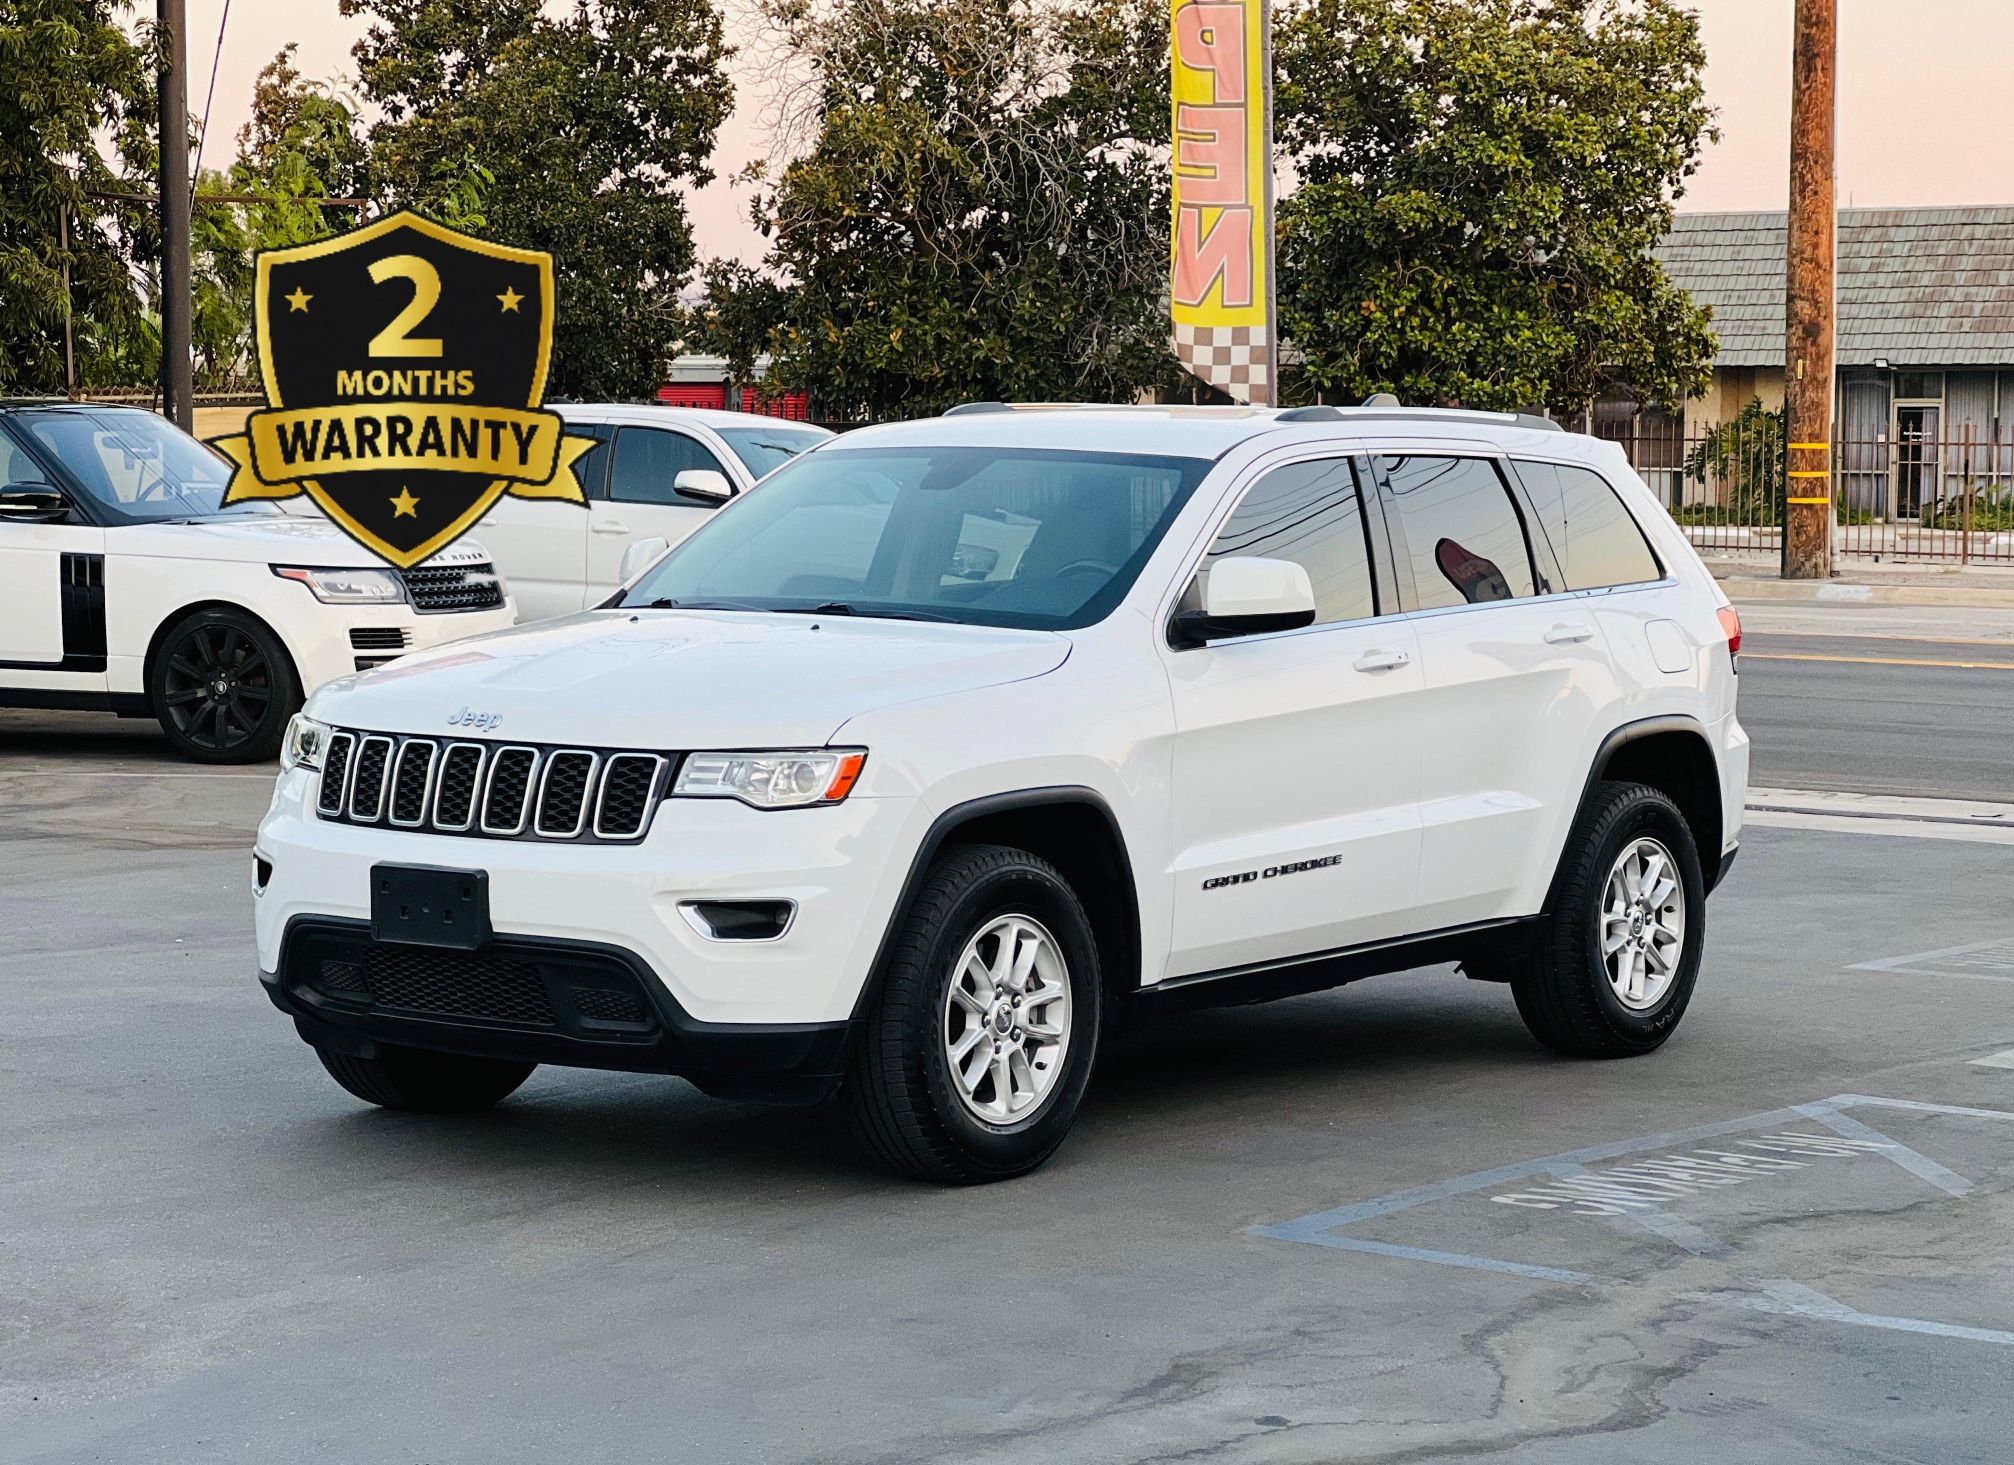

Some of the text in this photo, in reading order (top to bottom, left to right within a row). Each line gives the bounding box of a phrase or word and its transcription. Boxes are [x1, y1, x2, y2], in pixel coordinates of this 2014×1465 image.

[447, 706, 503, 733] Jeep
[1202, 854, 1342, 890] GRAND CHEROKEE
